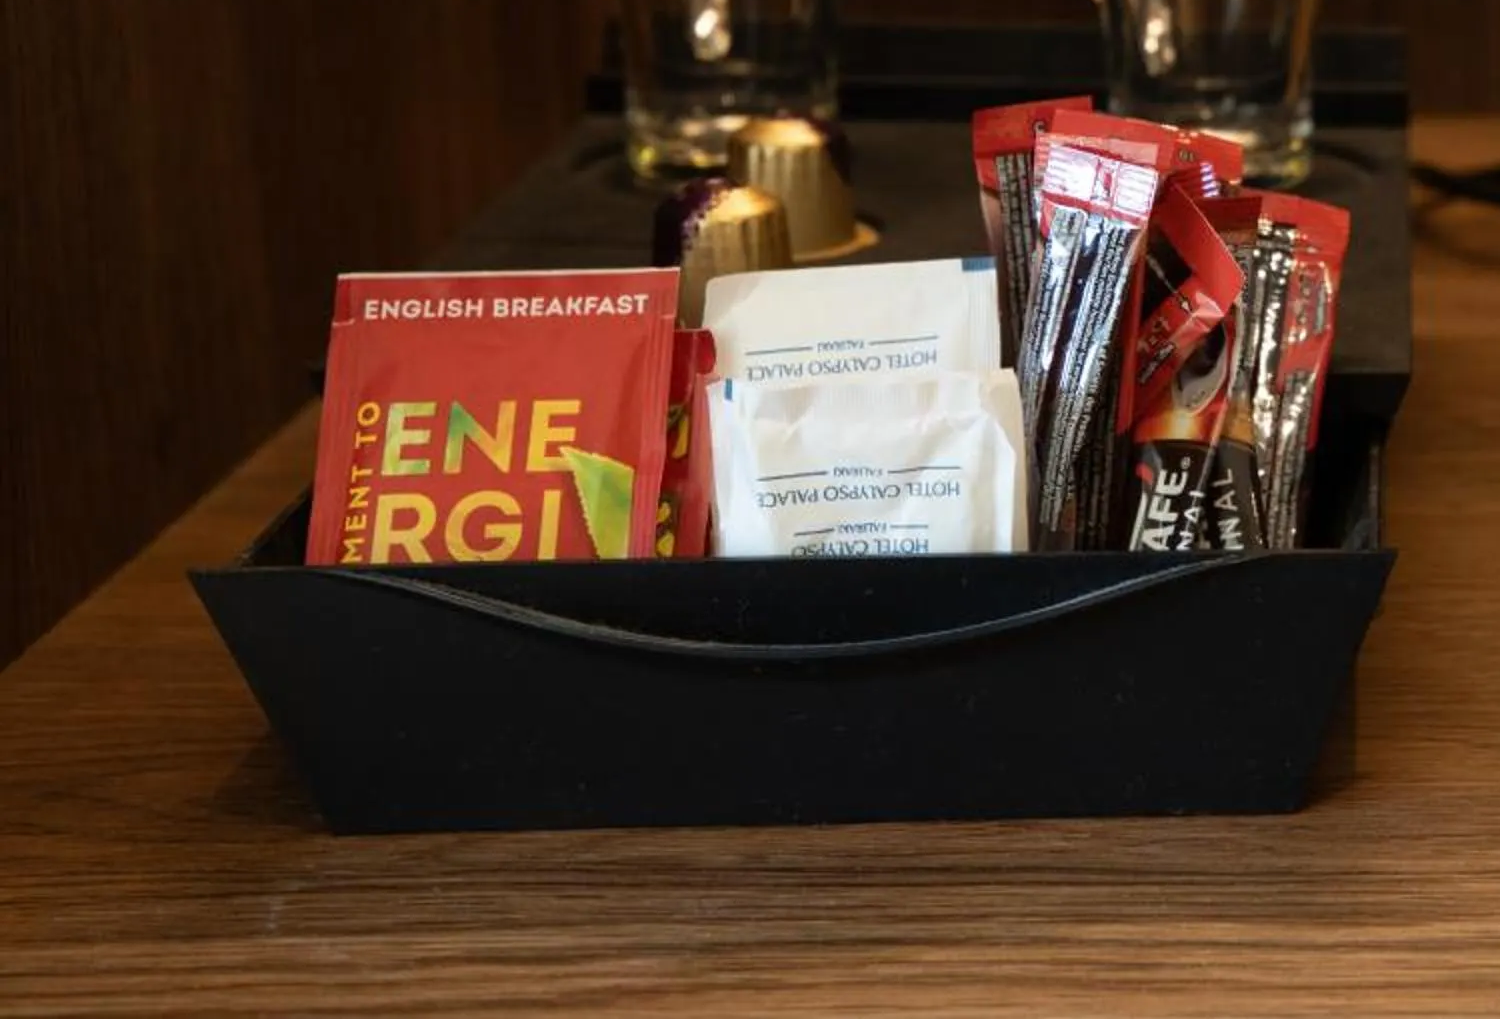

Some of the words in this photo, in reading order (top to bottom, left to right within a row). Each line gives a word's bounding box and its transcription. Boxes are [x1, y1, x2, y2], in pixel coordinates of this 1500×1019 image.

[363, 298, 484, 321] ENGLISH
[491, 293, 650, 319] BREAKFAST
[810, 356, 882, 376] CALYPSO
[886, 348, 938, 368] HOTEL
[355, 400, 382, 450] TO
[381, 399, 582, 477] ENE
[755, 488, 820, 509] PALACE
[822, 483, 901, 503] CALYPSO
[906, 480, 962, 498] HOTEL
[790, 537, 871, 558] CALYPSO
[873, 537, 930, 555] HOTEL
